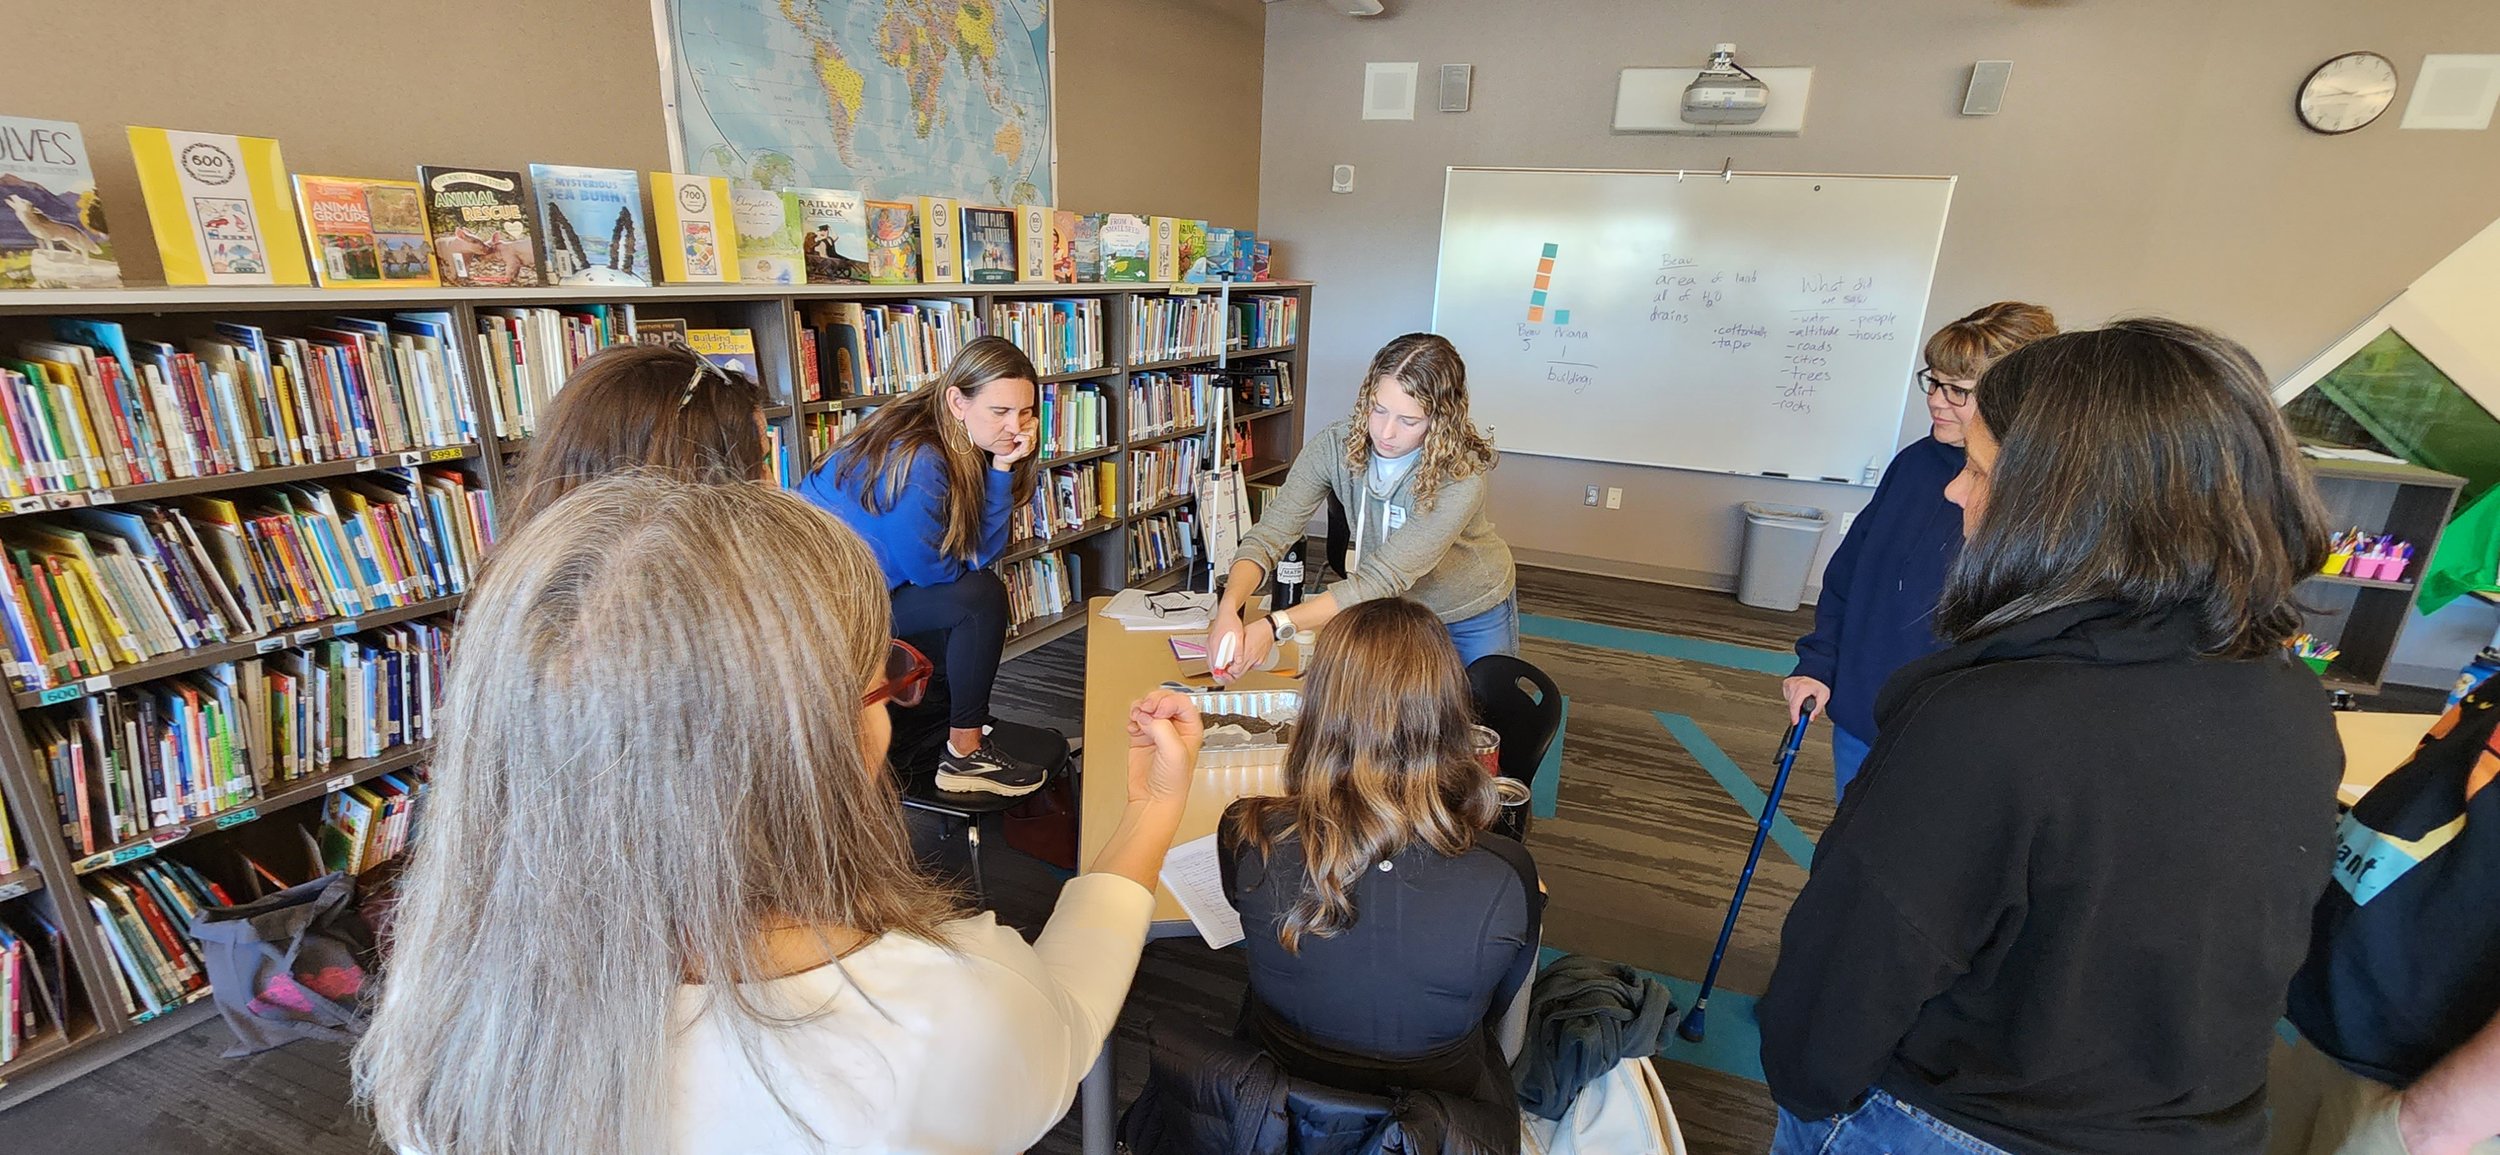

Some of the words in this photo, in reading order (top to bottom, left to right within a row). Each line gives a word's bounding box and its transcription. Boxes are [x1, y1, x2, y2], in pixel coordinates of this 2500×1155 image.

[192, 155, 223, 167] 600
[555, 177, 618, 189] MYSTERIOUS
[434, 190, 499, 208] ANIMAL
[547, 188, 575, 201] SEA
[684, 190, 700, 200] 700
[313, 201, 367, 213] ANIMAL
[798, 199, 854, 210] RAILWAY
[313, 211, 370, 223] GROUPS
[461, 205, 522, 222] RESCUE
[808, 208, 843, 217] JACK
[1661, 253, 1693, 267] Beau
[1656, 274, 1697, 286] area
[1802, 273, 1845, 293] What
[1853, 276, 1872, 291] did
[1174, 284, 1194, 293] Biography
[1650, 305, 1689, 324] drains
[693, 333, 730, 344] Building
[1522, 338, 1532, 352] 5
[1547, 366, 1593, 395] buildings
[47, 687, 77, 702] 600
